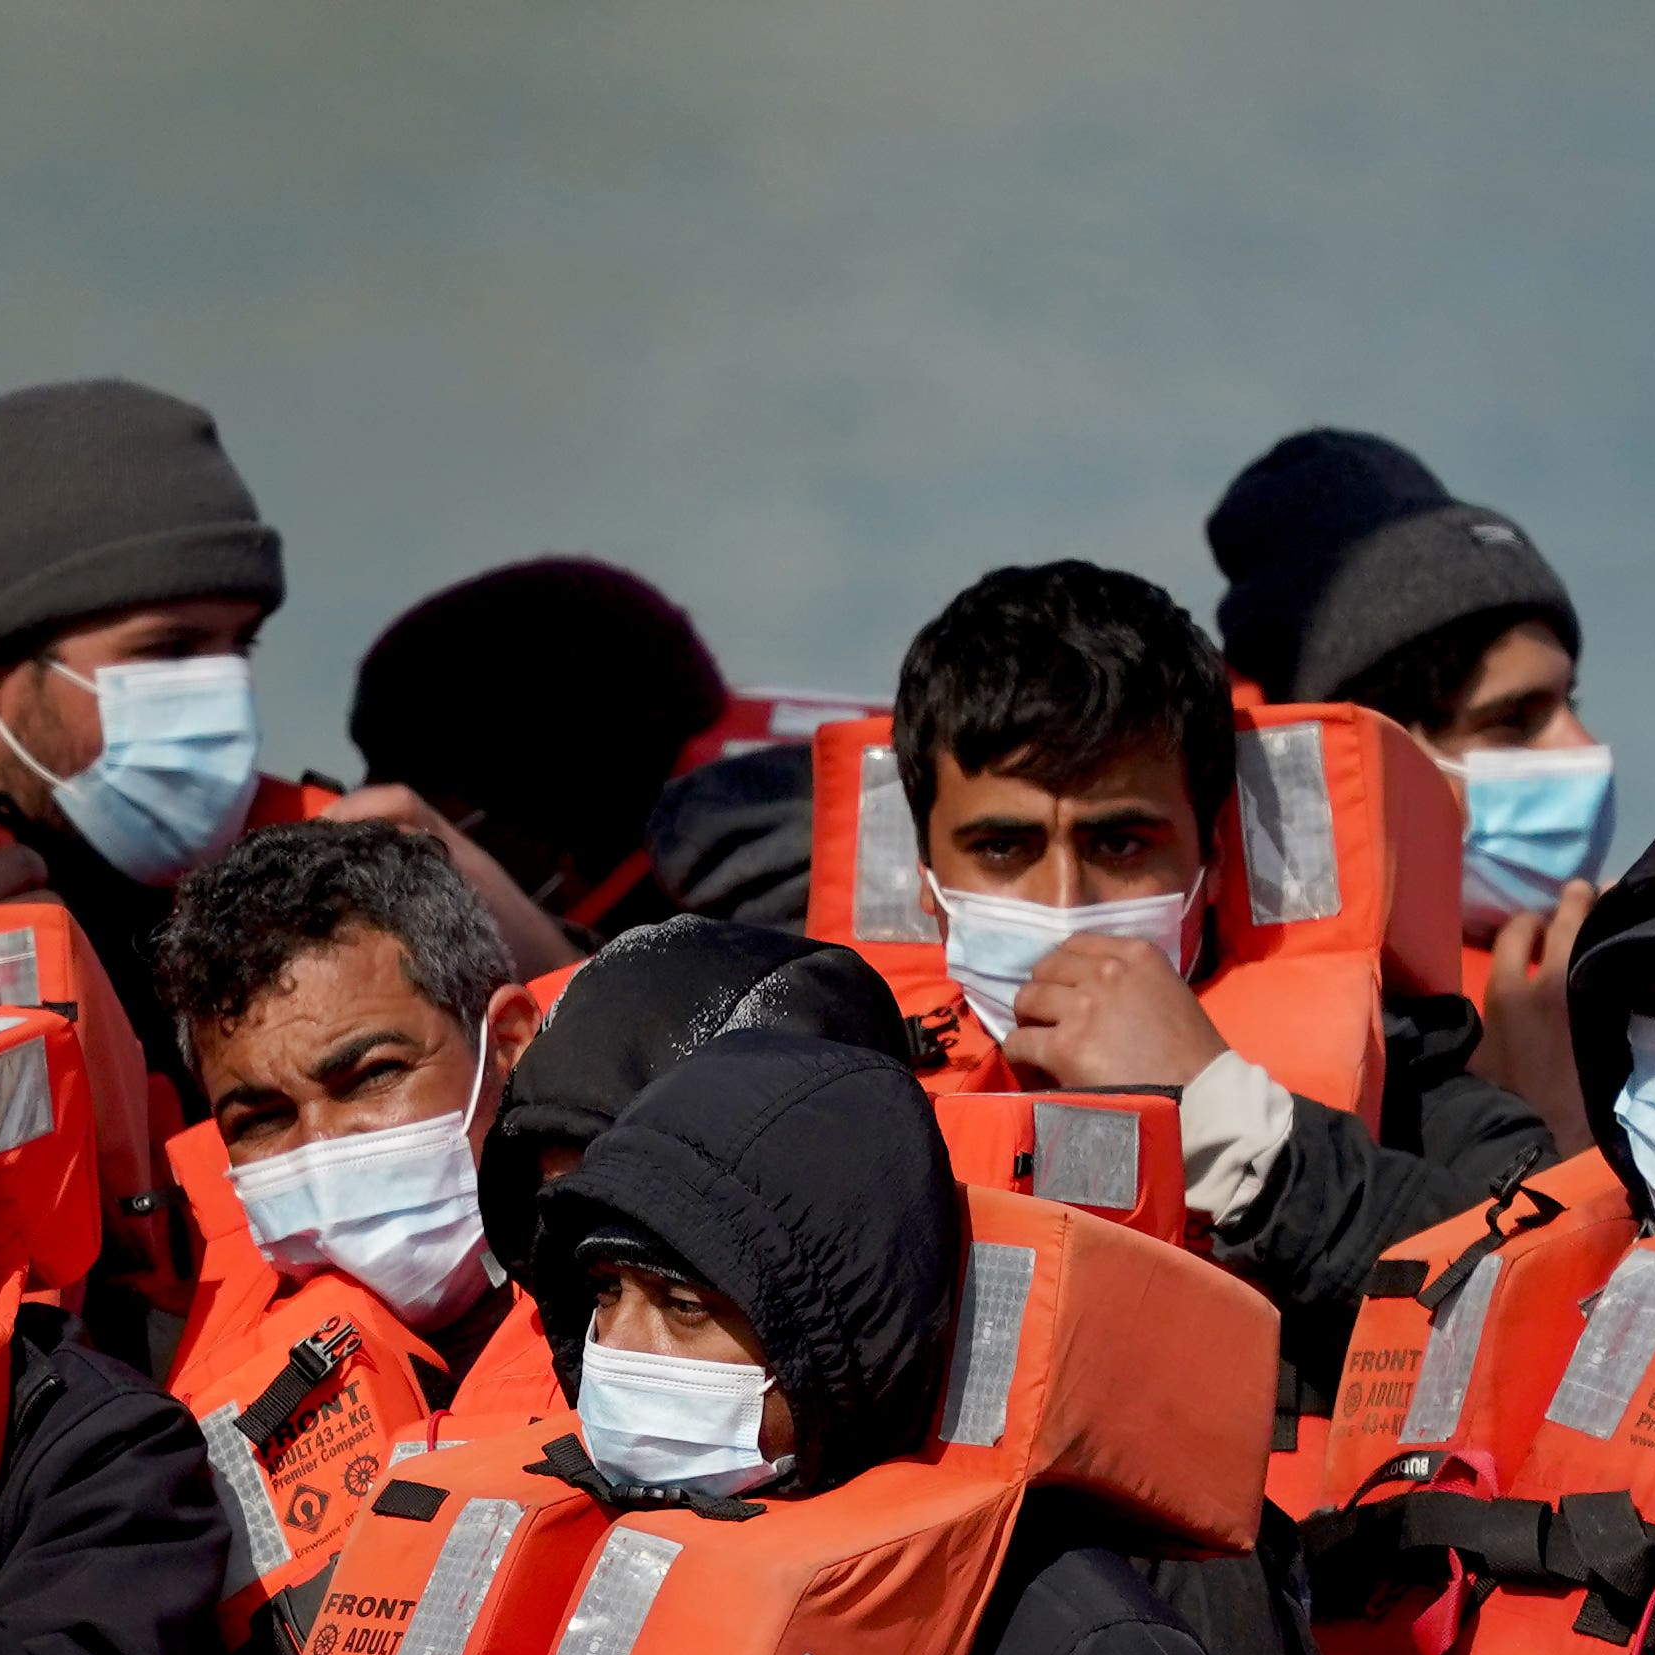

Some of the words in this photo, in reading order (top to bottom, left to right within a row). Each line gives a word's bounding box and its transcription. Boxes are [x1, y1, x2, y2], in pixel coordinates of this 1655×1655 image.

[1348, 1350, 1423, 1373] FRONT
[1365, 1381, 1415, 1409] ADULT
[266, 1436, 312, 1481] ADULT
[270, 1459, 318, 1494] Premier
[321, 1422, 376, 1464] Compact
[324, 1593, 418, 1621] FRONT
